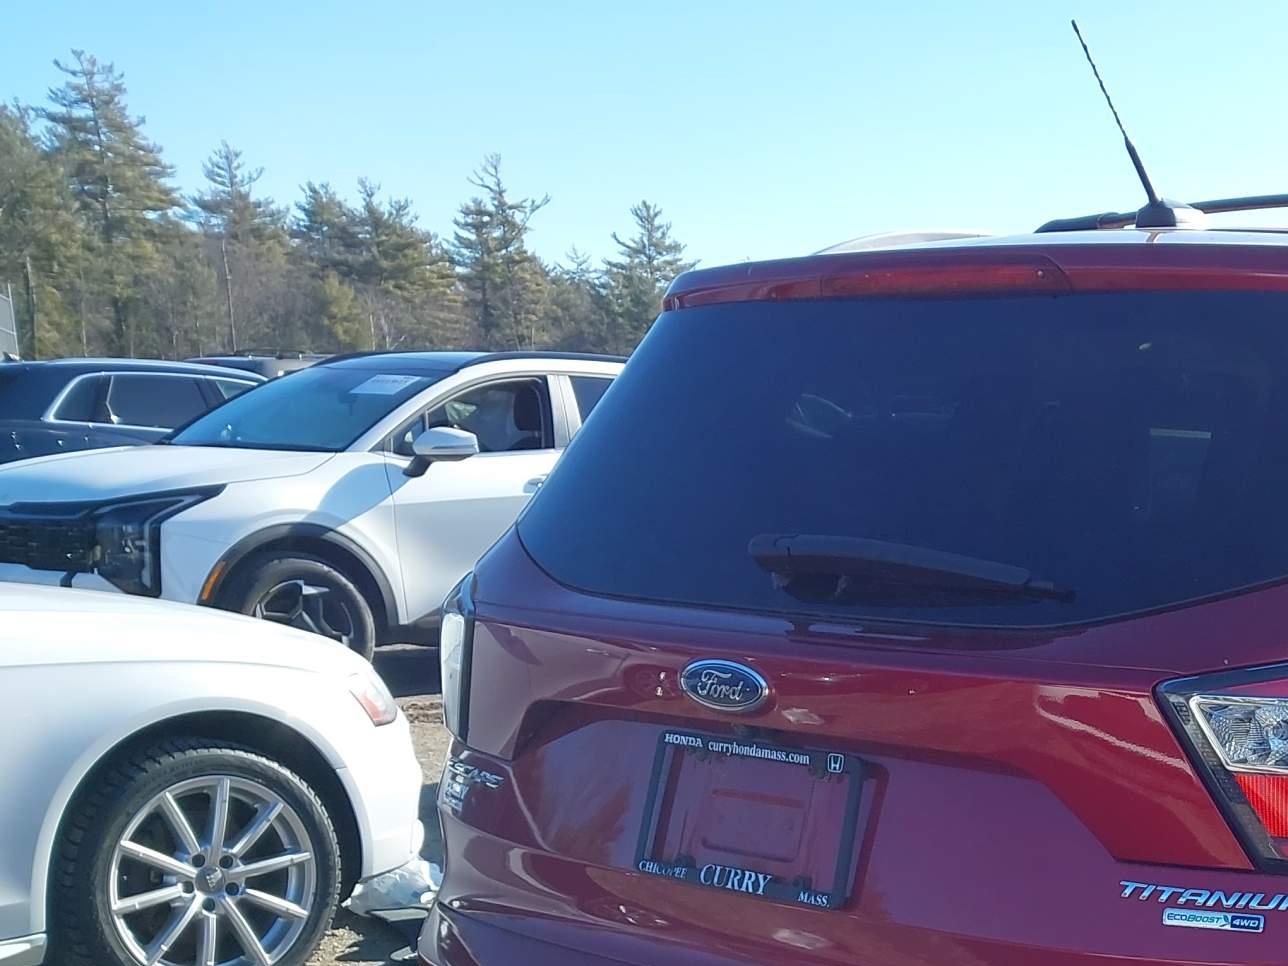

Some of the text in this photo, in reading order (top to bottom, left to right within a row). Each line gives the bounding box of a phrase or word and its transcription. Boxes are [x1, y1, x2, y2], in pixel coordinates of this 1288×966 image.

[697, 669, 744, 701] Ford
[664, 733, 704, 749] HONDA
[708, 739, 810, 766] curryhondamass.com
[699, 863, 773, 896] CURRY
[798, 890, 830, 909] MASS.
[1232, 918, 1260, 929] 4WD
